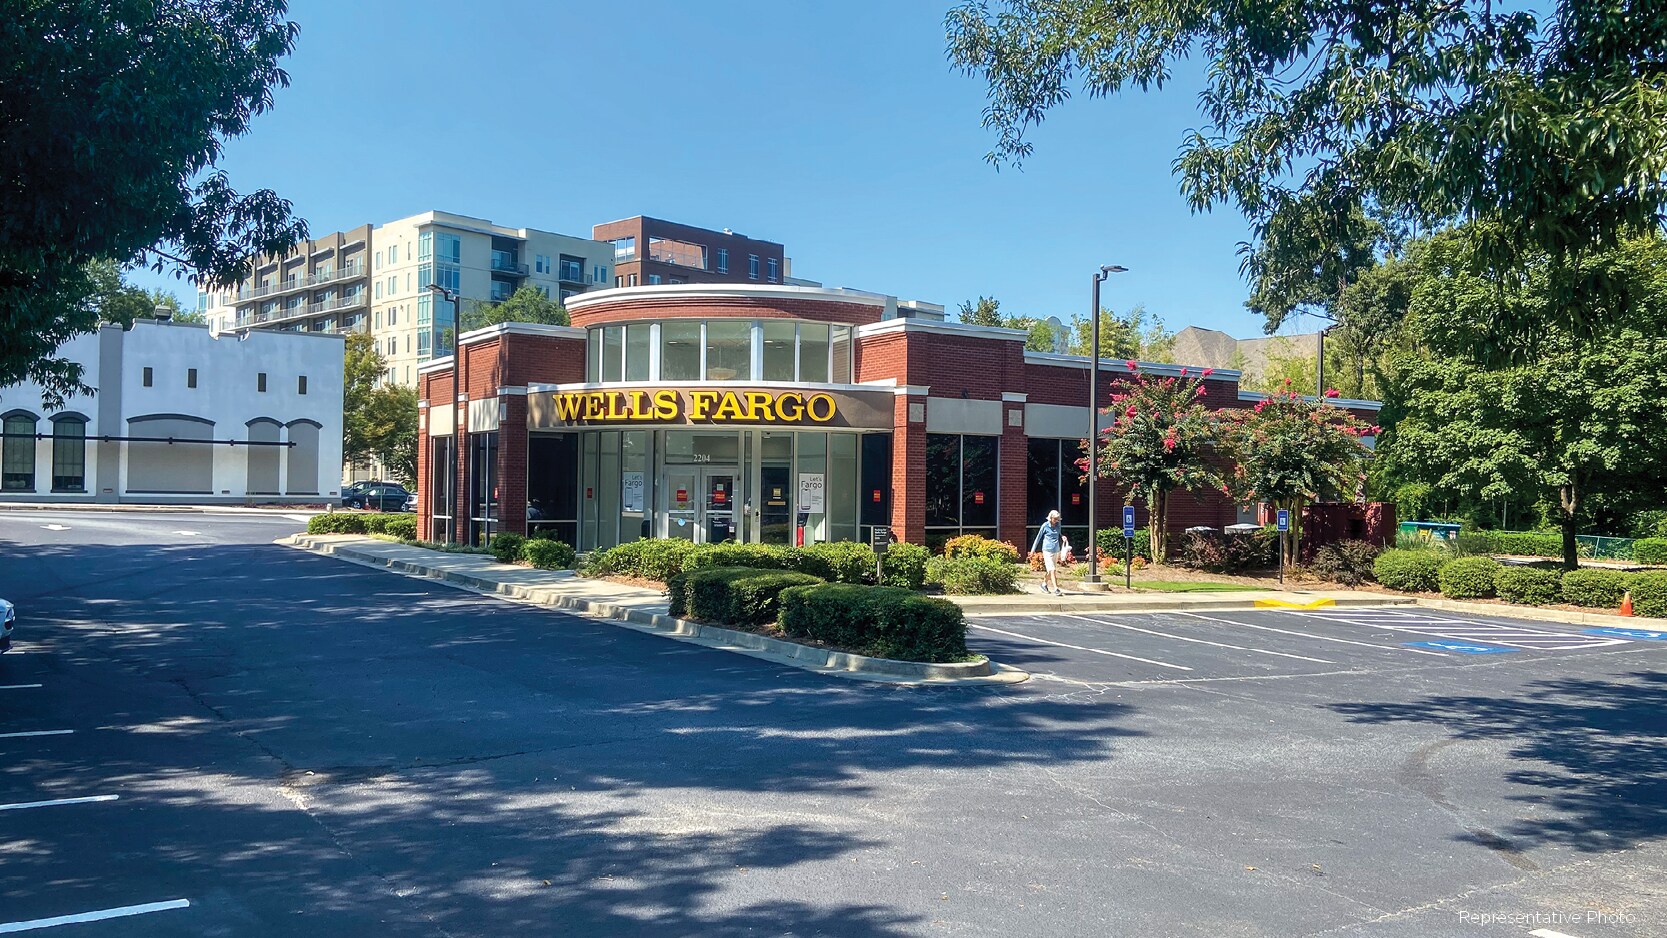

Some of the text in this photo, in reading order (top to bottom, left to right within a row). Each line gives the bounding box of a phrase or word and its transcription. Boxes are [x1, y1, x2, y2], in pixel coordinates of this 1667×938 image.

[552, 390, 837, 422] WELLS FARGO
[693, 454, 710, 462] 2204
[625, 480, 642, 488] Fargo
[801, 480, 822, 490] Fargo
